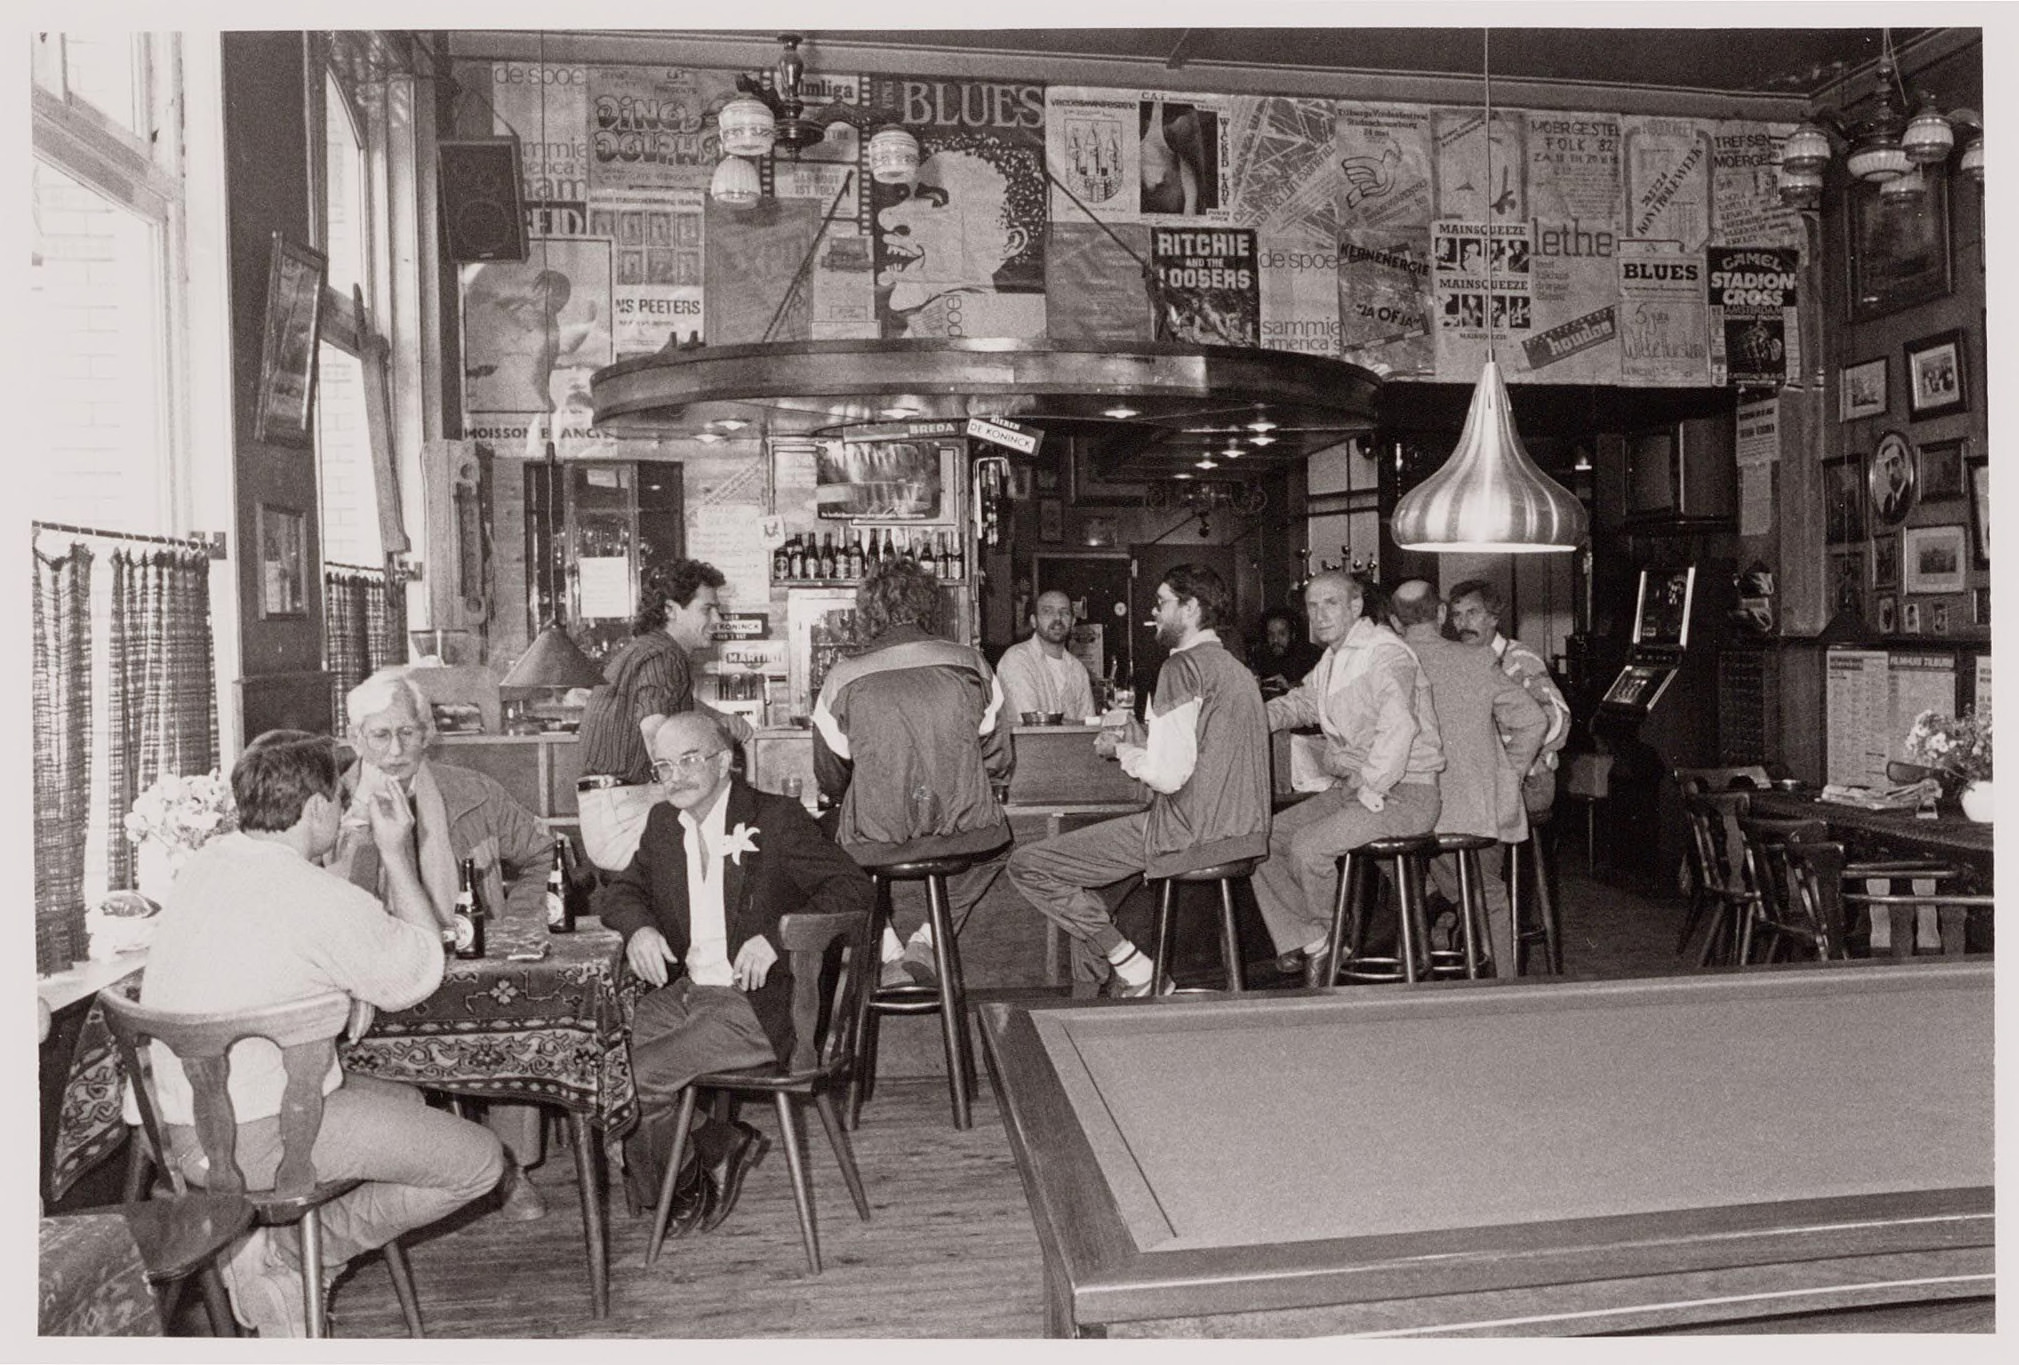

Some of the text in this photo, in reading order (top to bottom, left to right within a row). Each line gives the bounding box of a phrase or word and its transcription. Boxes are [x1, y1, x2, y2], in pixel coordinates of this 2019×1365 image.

[495, 62, 524, 84] de
[901, 81, 1046, 128] BLUES
[1531, 121, 1620, 137] MOERGESTEL
[1544, 137, 1585, 152] FOLK
[1157, 233, 1250, 257] RITCHIE
[1531, 217, 1613, 257] lethe
[1185, 258, 1225, 268] AND THE
[1259, 249, 1285, 270] de
[1341, 242, 1430, 276] KERNENERGIE
[1722, 252, 1783, 271] CAMEL
[1623, 263, 1698, 281] BLUES
[1711, 271, 1796, 290] STADION
[1722, 288, 1784, 306] CROSS
[639, 299, 701, 315] PEETERS
[1262, 315, 1341, 336] sammie
[908, 422, 955, 434] BREDA
[983, 426, 1031, 449] KONINCK
